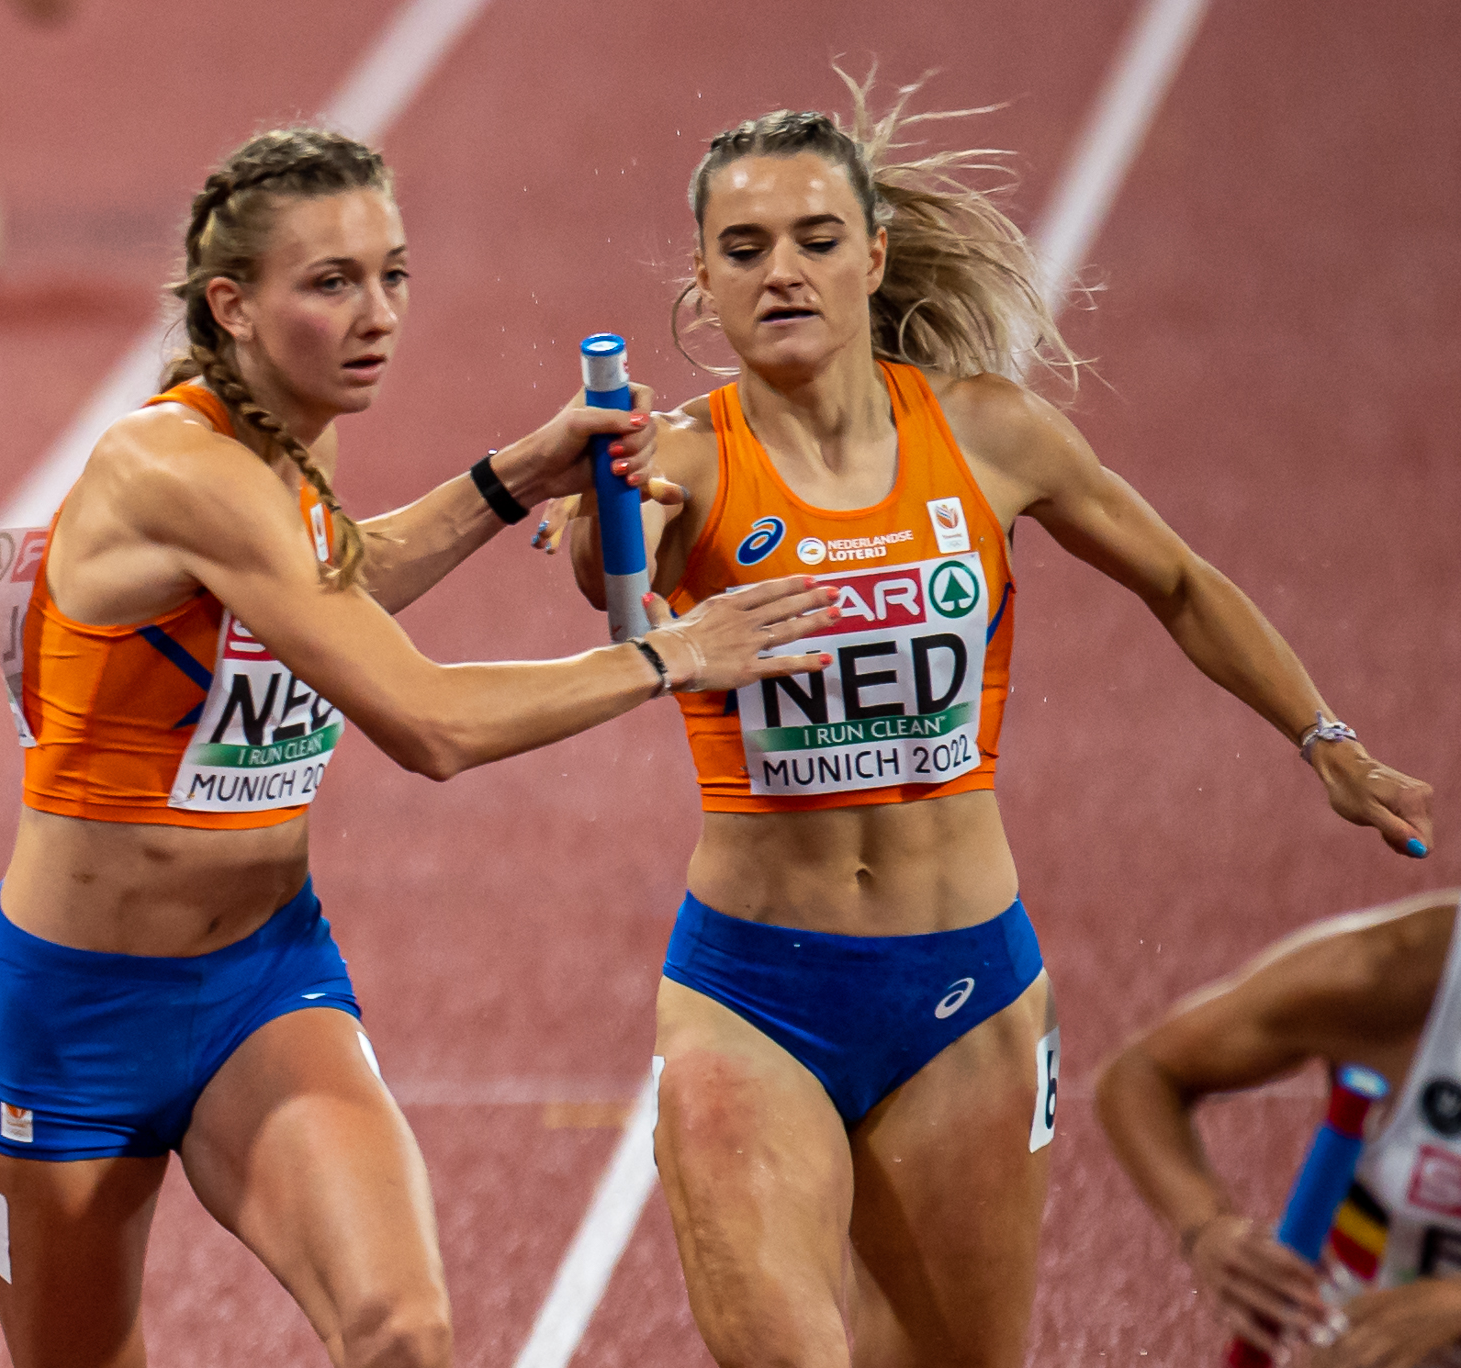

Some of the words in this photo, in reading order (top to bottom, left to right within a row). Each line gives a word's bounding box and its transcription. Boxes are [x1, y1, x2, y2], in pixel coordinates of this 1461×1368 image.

[827, 529, 914, 550] NEDERLANDSE
[828, 546, 887, 562] LOTERIJ
[828, 577, 921, 622] AR
[758, 632, 968, 729] NED
[803, 729, 810, 746] I
[817, 723, 864, 745] RUN
[238, 749, 244, 765] I
[248, 747, 283, 766] RUN
[762, 747, 900, 787] MUNICH
[913, 733, 972, 774] 2022
[189, 768, 297, 802] MUNICH
